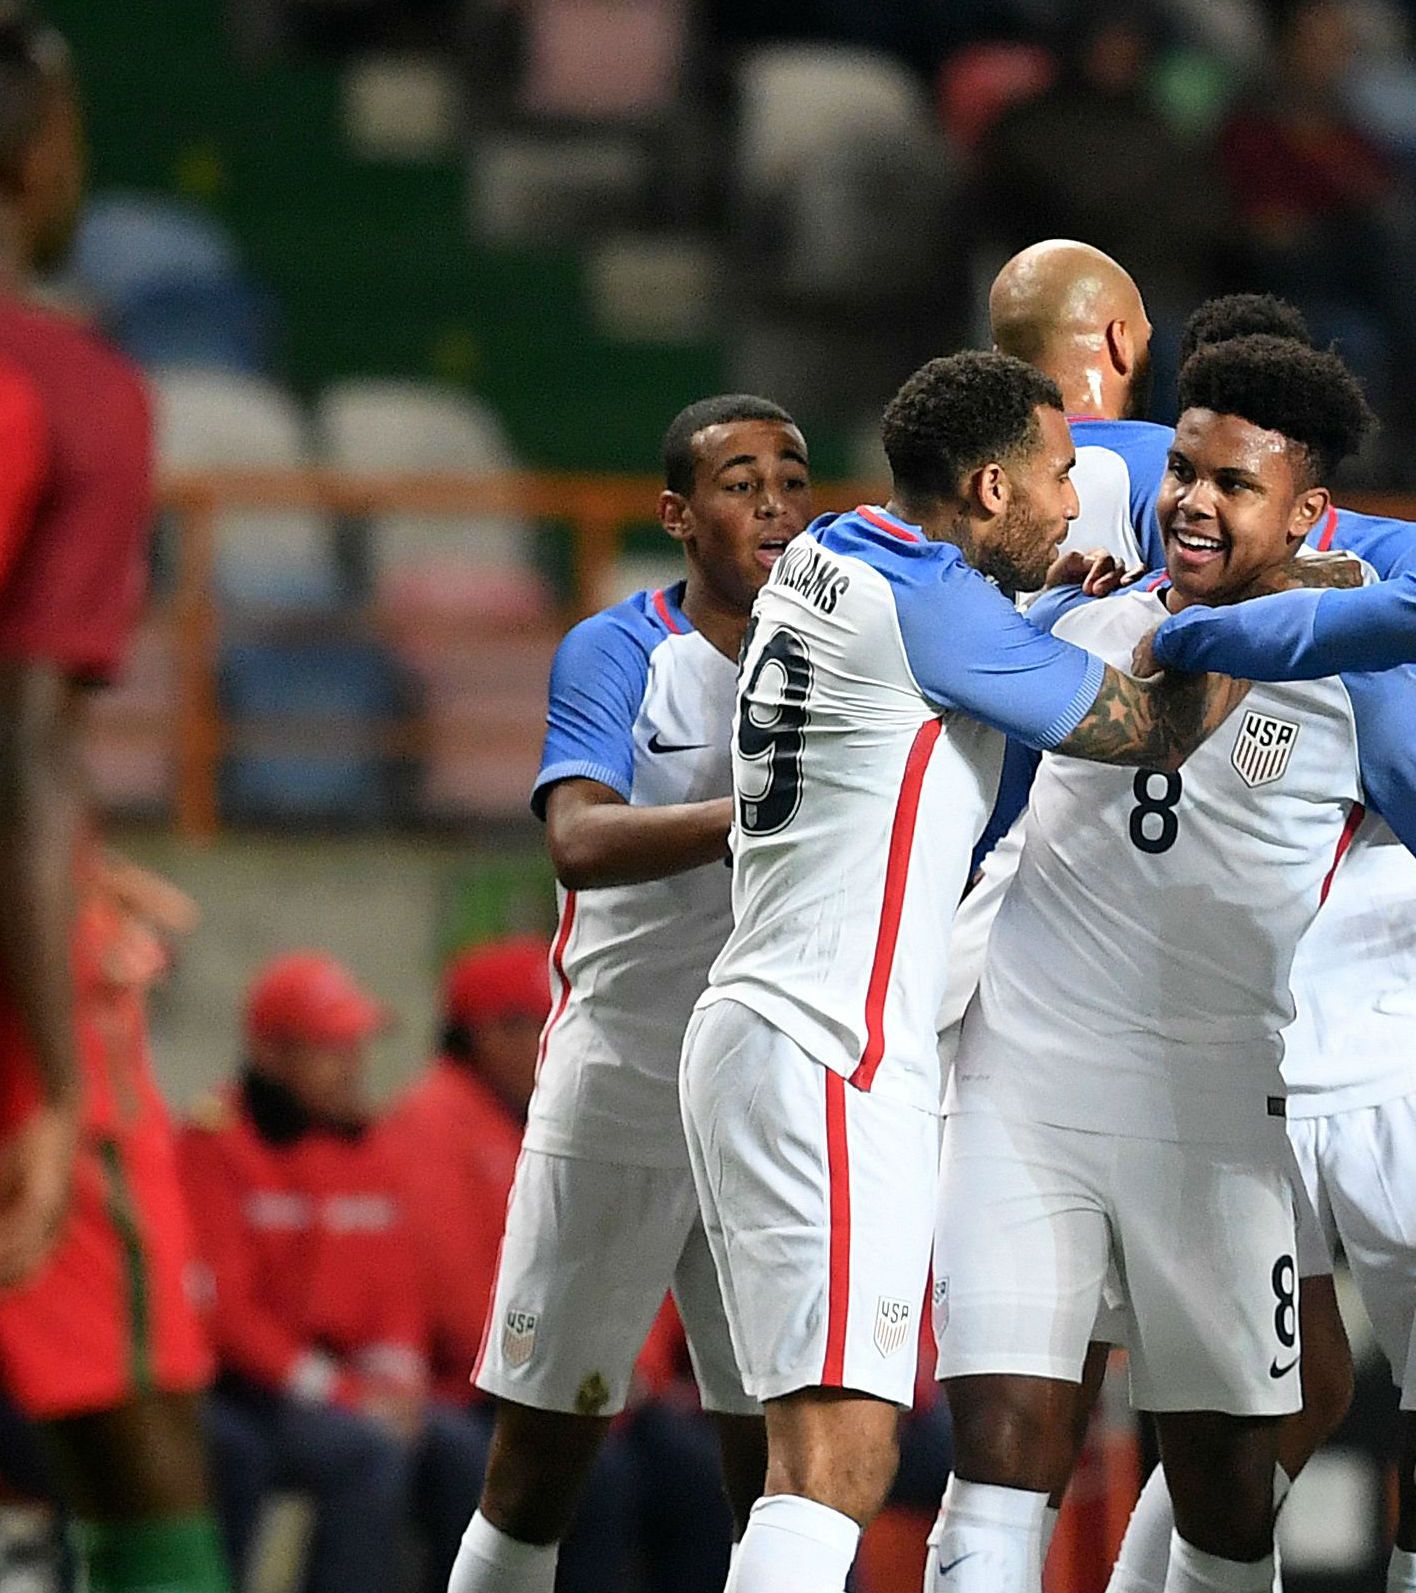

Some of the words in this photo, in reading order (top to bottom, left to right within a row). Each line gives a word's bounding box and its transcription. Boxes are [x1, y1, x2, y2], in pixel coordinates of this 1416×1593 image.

[736, 614, 814, 837] 9
[1246, 715, 1293, 746] USA
[1129, 768, 1182, 854] 8
[506, 1311, 536, 1334] USA
[881, 1300, 909, 1324] USA
[1271, 1254, 1295, 1348] 8
